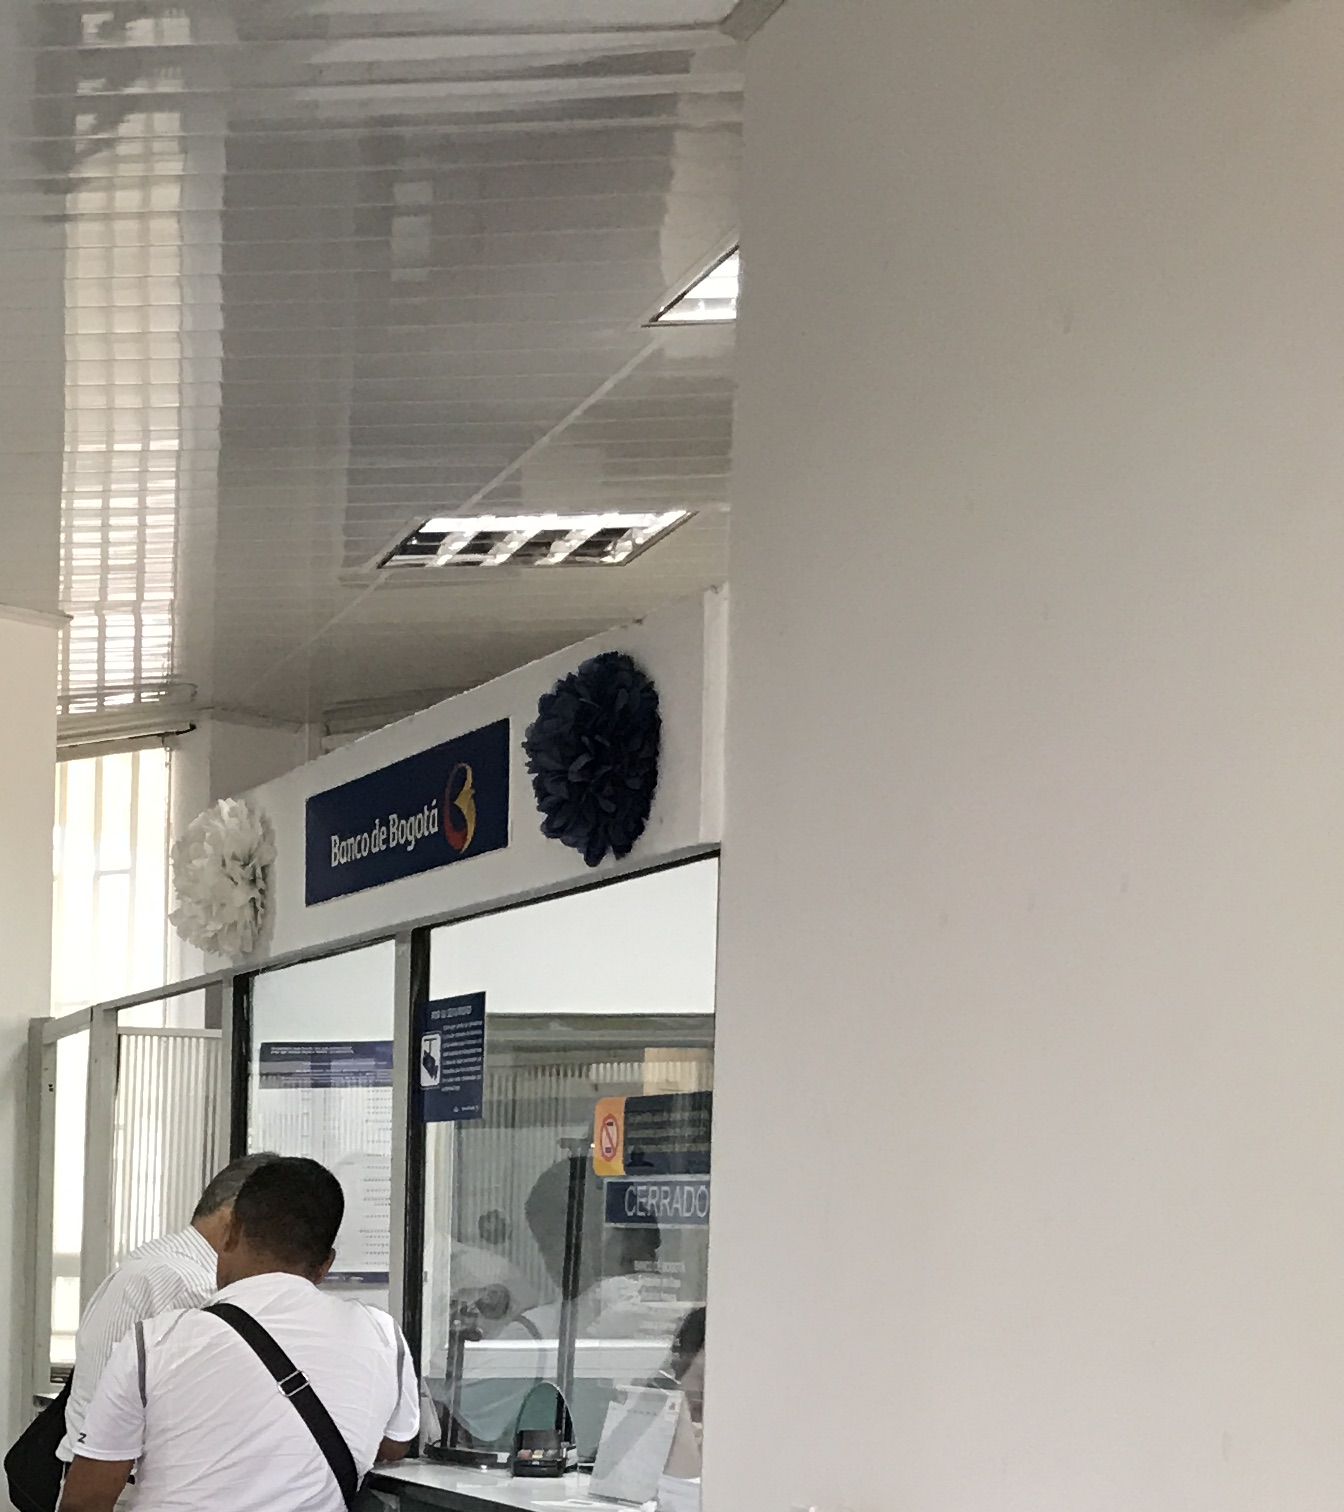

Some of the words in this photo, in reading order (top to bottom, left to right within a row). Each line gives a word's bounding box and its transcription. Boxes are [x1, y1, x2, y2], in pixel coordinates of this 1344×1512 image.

[331, 835, 369, 868] Banco
[371, 818, 387, 853] de
[389, 798, 439, 852] Bogotá
[624, 1185, 709, 1217] CERRADO
